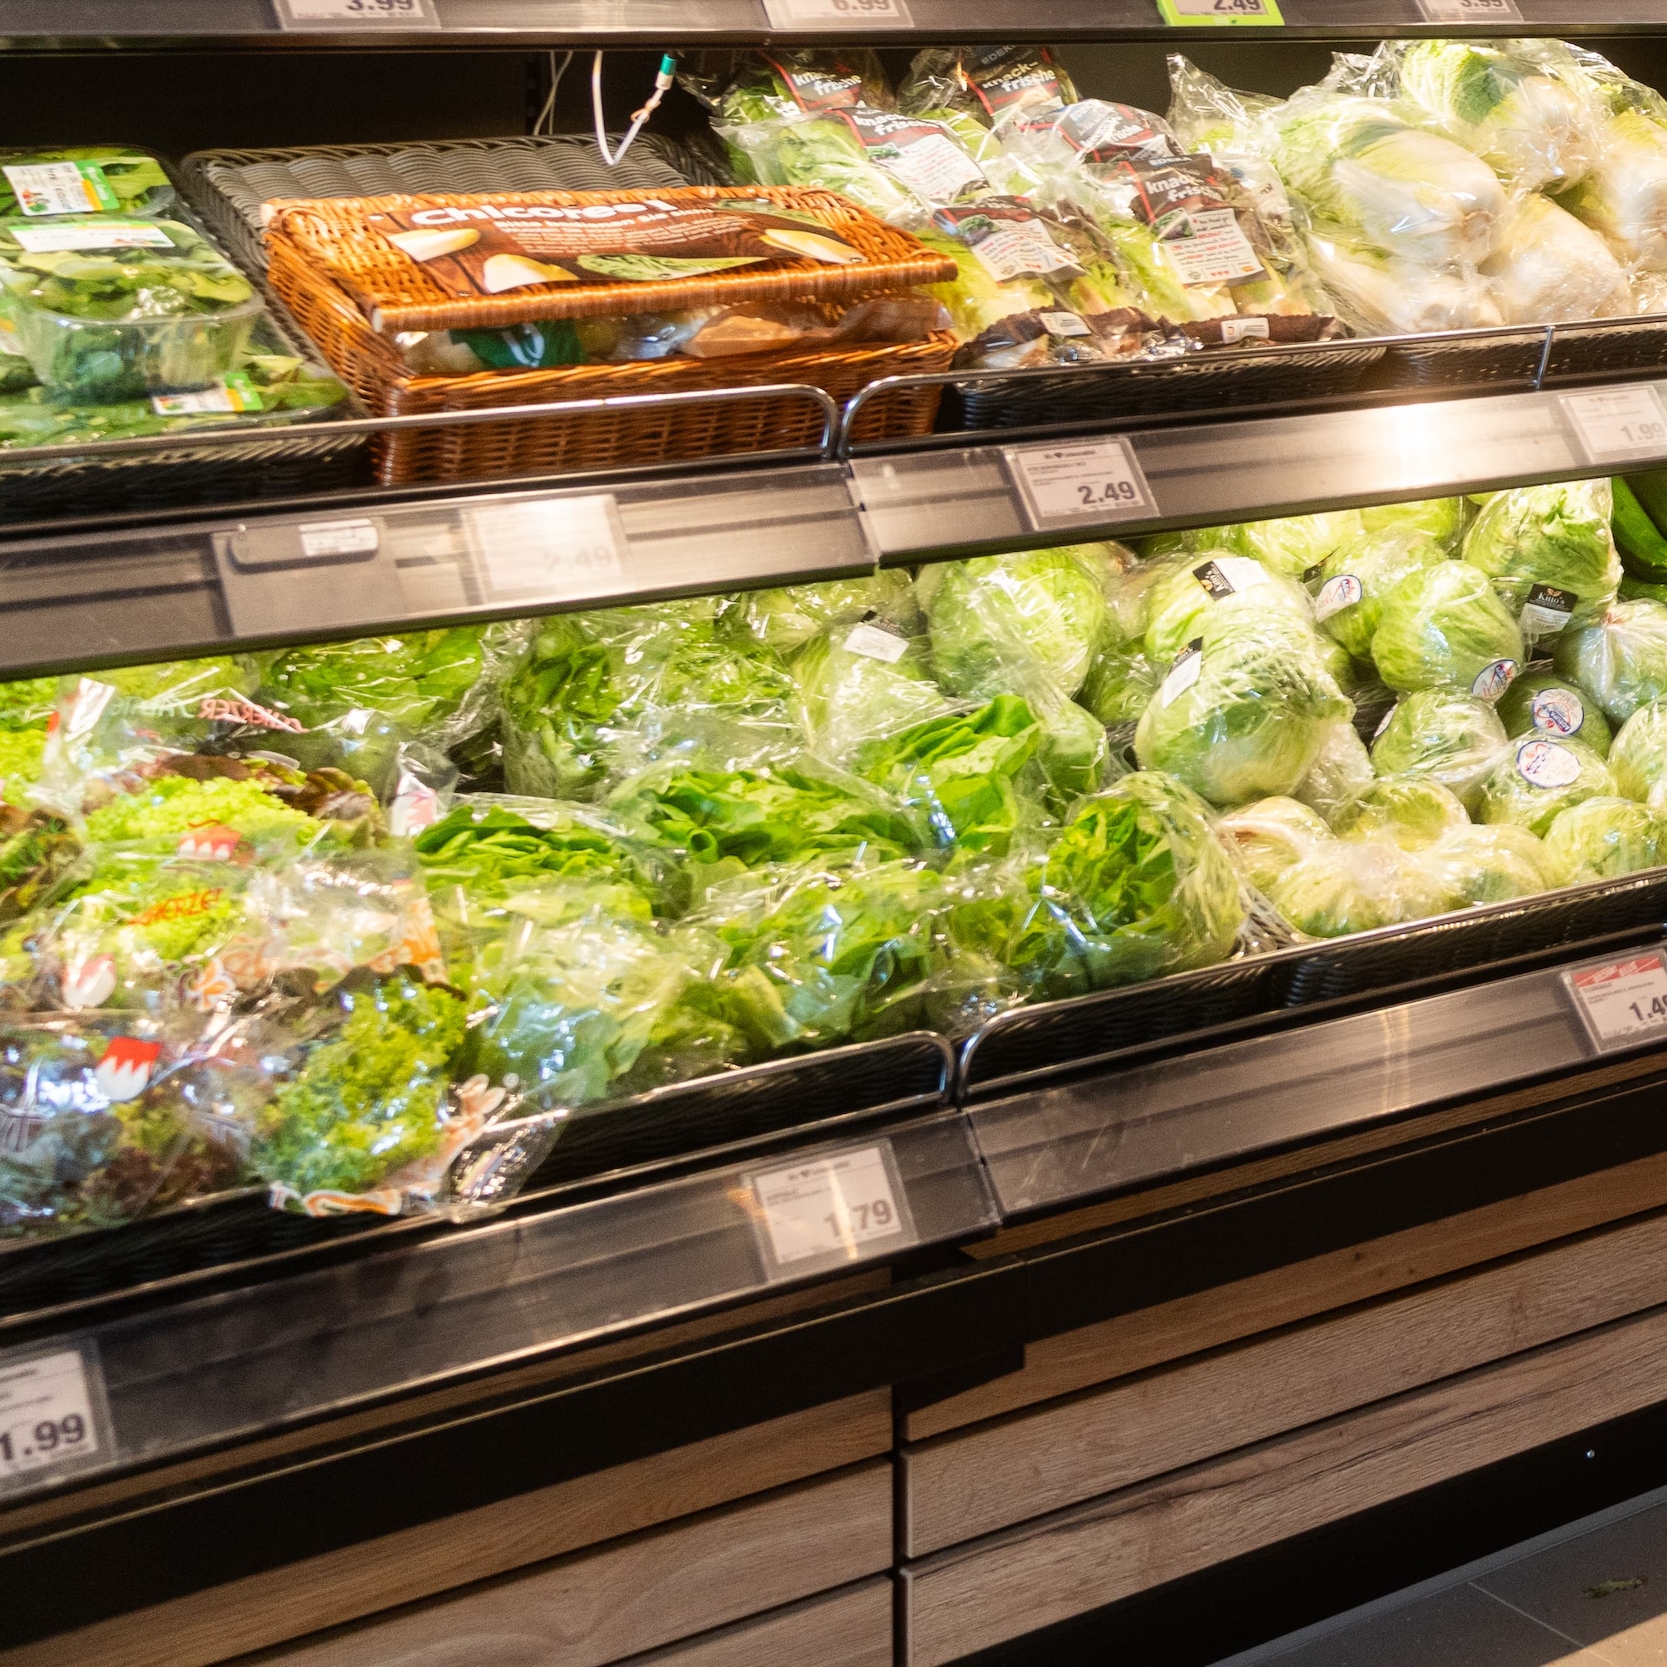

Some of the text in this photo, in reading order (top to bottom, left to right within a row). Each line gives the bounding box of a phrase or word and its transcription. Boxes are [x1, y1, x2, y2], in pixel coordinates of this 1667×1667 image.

[1001, 69, 1056, 93] frische
[1620, 421, 1666, 444] 1.99
[1078, 481, 1136, 505] 2.49
[0, 1414, 86, 1463] 1.99
